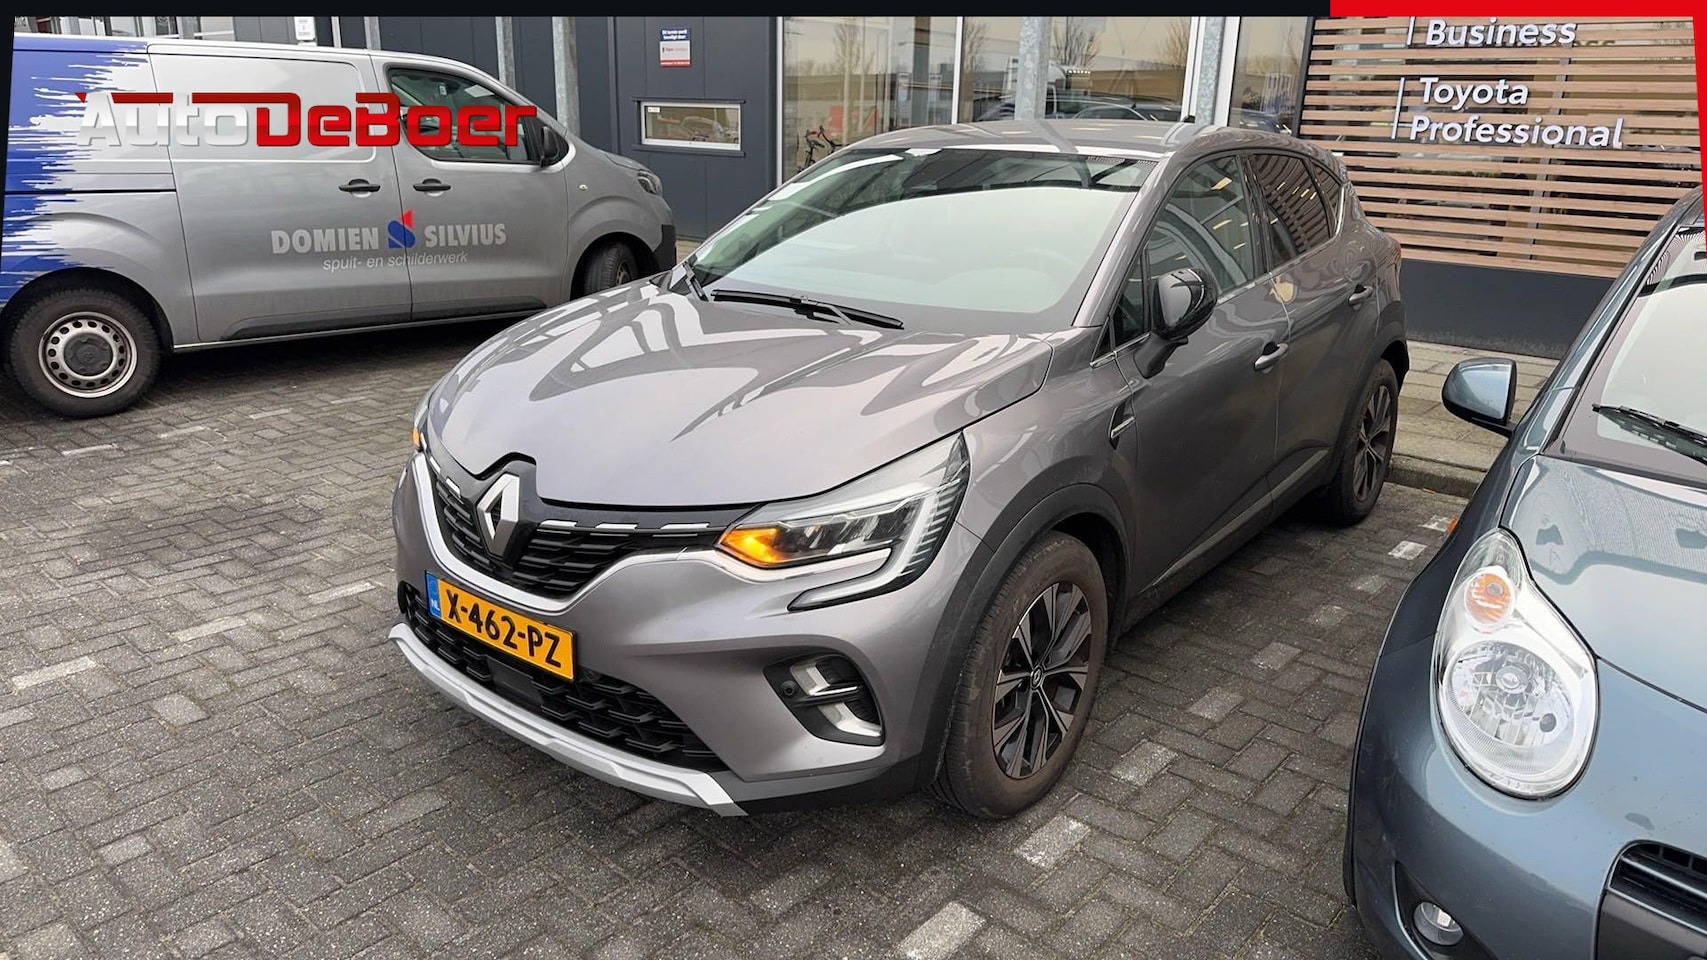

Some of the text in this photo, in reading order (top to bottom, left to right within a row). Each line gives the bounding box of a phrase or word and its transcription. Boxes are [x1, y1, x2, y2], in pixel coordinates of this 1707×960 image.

[1426, 17, 1577, 46] Business
[1419, 77, 1529, 111] Toyota
[1410, 115, 1624, 149] Professional
[271, 223, 507, 254] DOMIEN SILVIUS
[322, 251, 469, 273] spuit- en schilderwerk
[430, 598, 440, 611] NL
[446, 589, 562, 668] X-462-PZ
